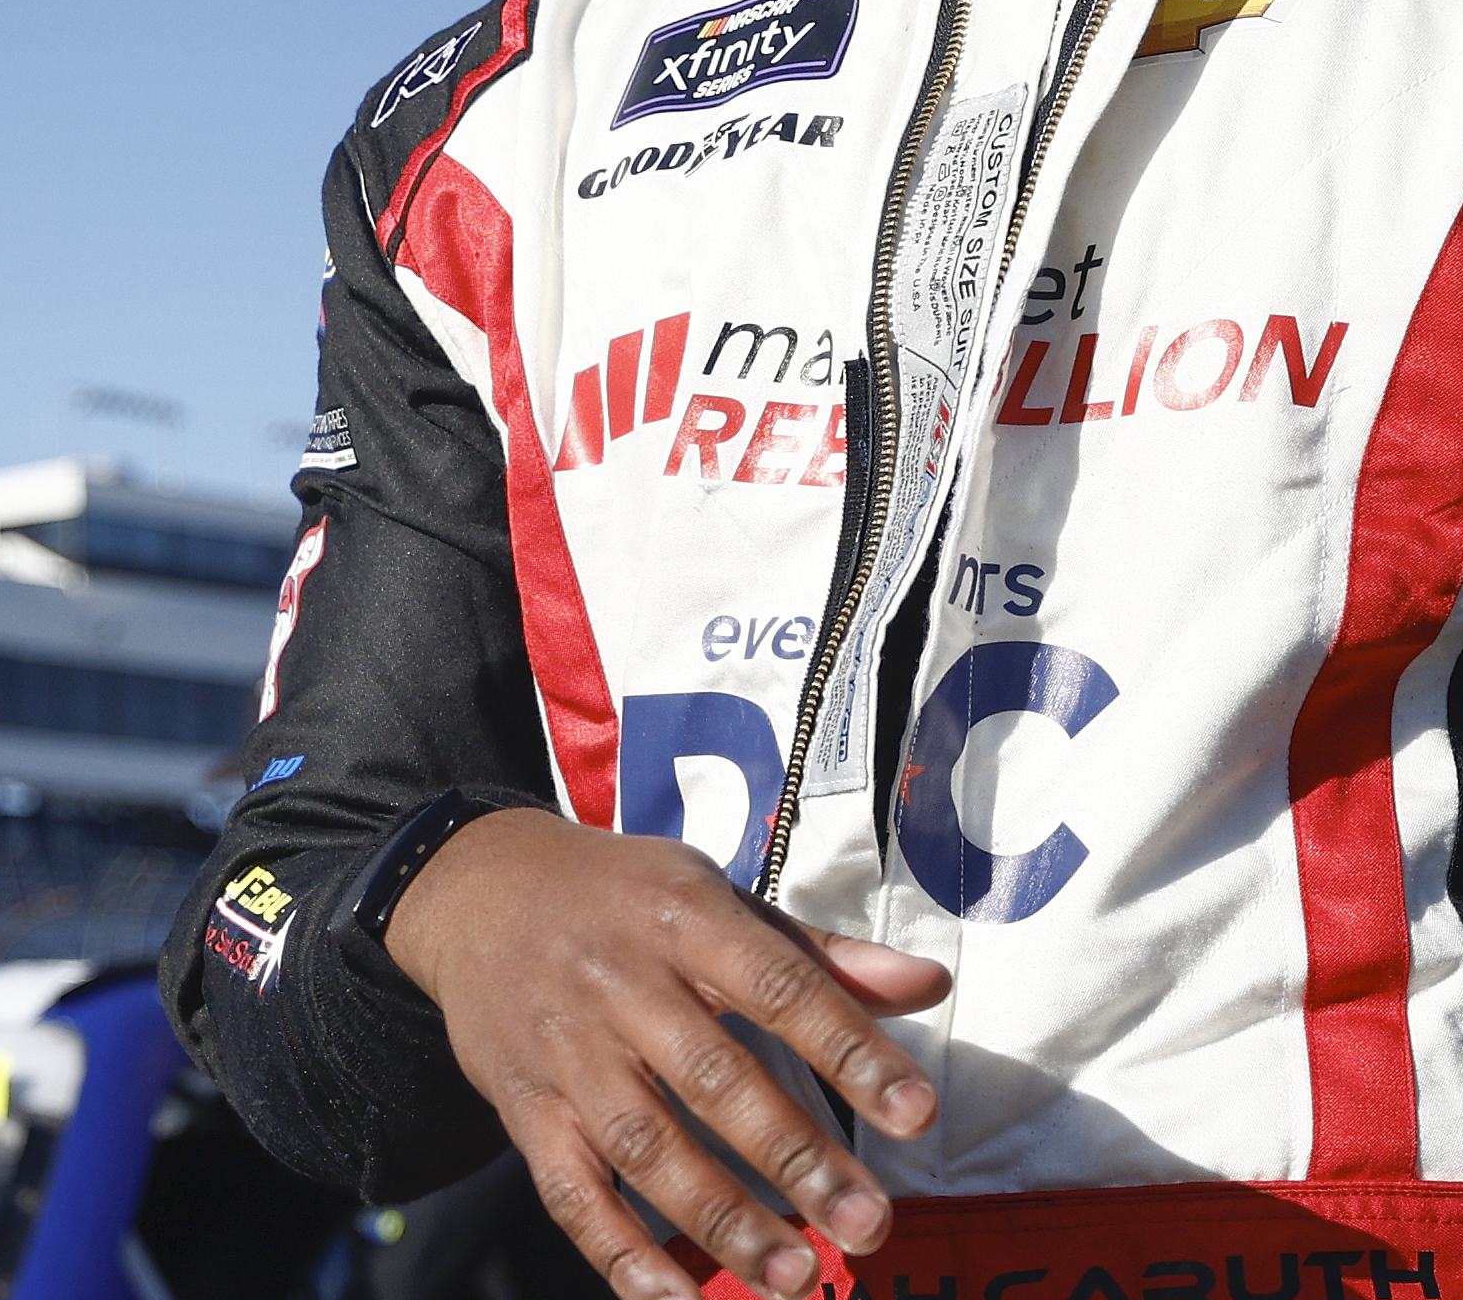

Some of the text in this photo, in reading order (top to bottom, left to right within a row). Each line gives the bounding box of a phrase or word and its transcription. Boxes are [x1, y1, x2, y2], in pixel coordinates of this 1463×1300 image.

[653, 20, 817, 91] xfinity
[692, 63, 756, 99] SERIES
[577, 112, 845, 200] GOODYEAR
[953, 109, 1012, 371] CUSTOM SIZE SUIT
